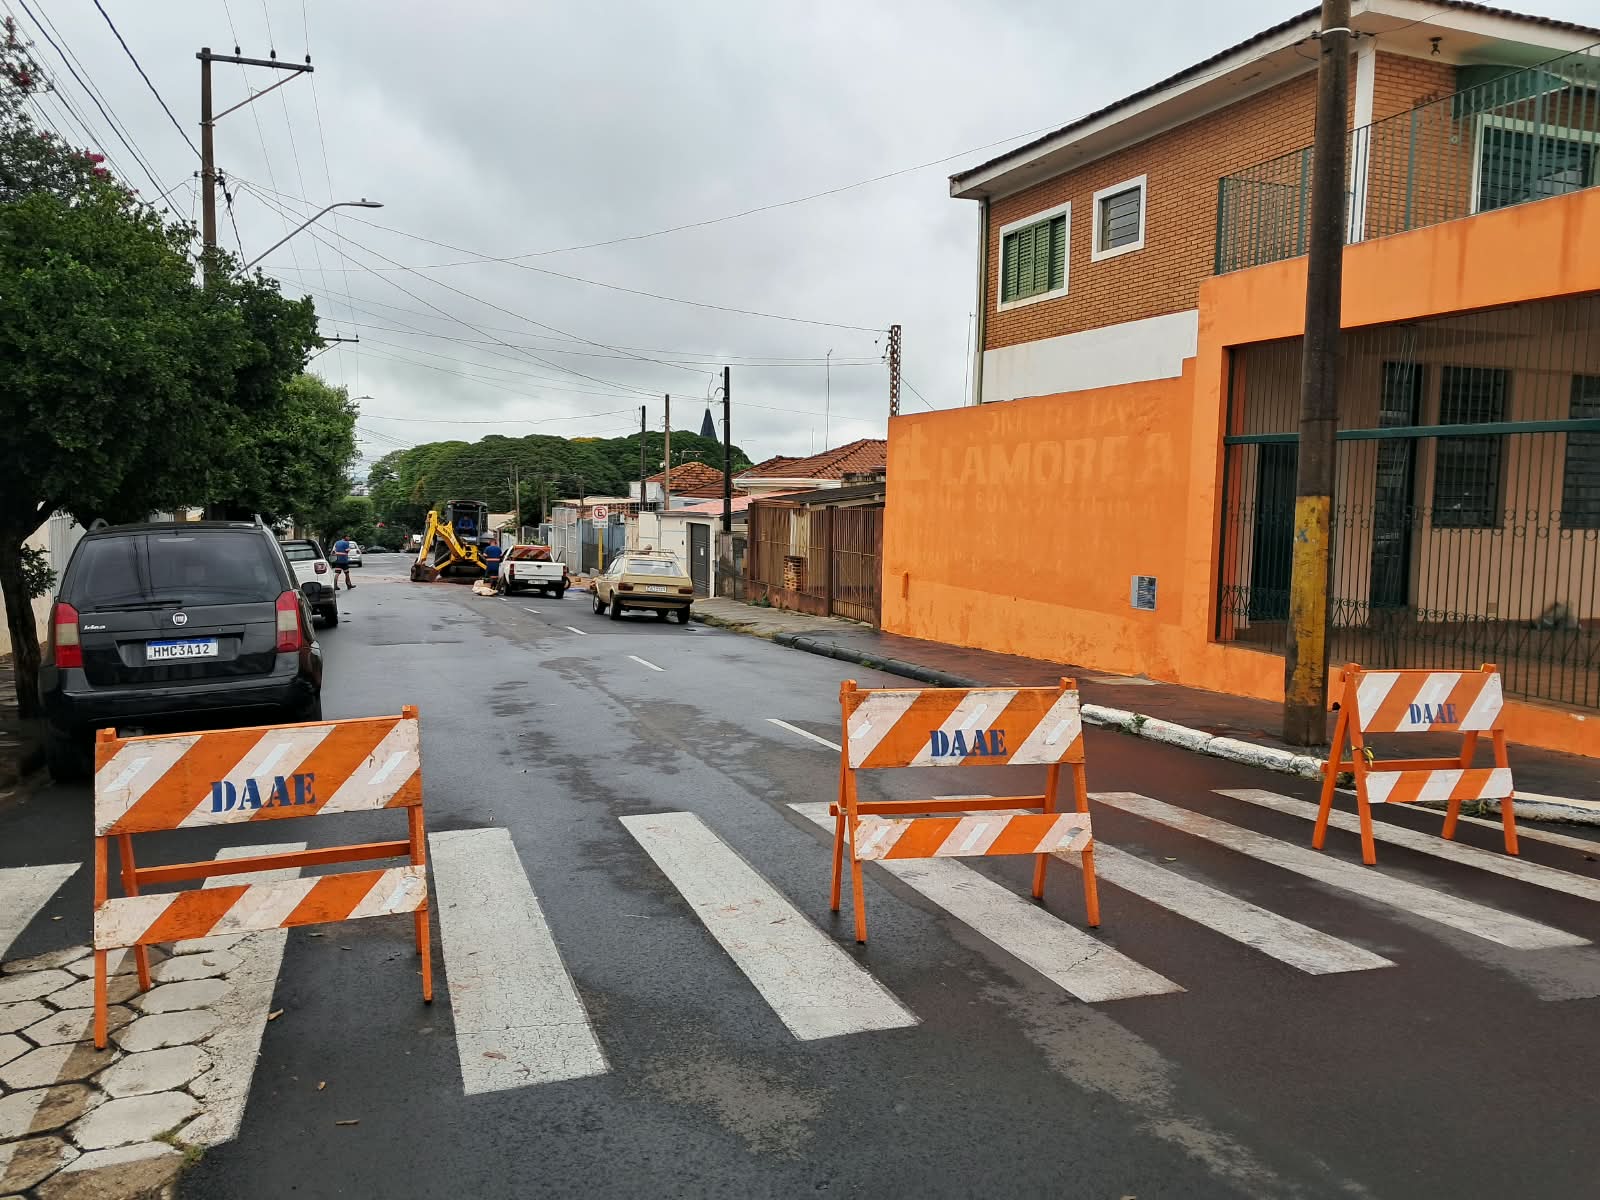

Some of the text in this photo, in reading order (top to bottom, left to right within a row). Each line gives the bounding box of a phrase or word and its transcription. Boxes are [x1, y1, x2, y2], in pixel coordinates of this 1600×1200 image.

[153, 644, 209, 657] HMC3A12
[1408, 703, 1458, 724] DAAE
[929, 729, 1007, 757] DAAE
[210, 772, 316, 813] DAAE
